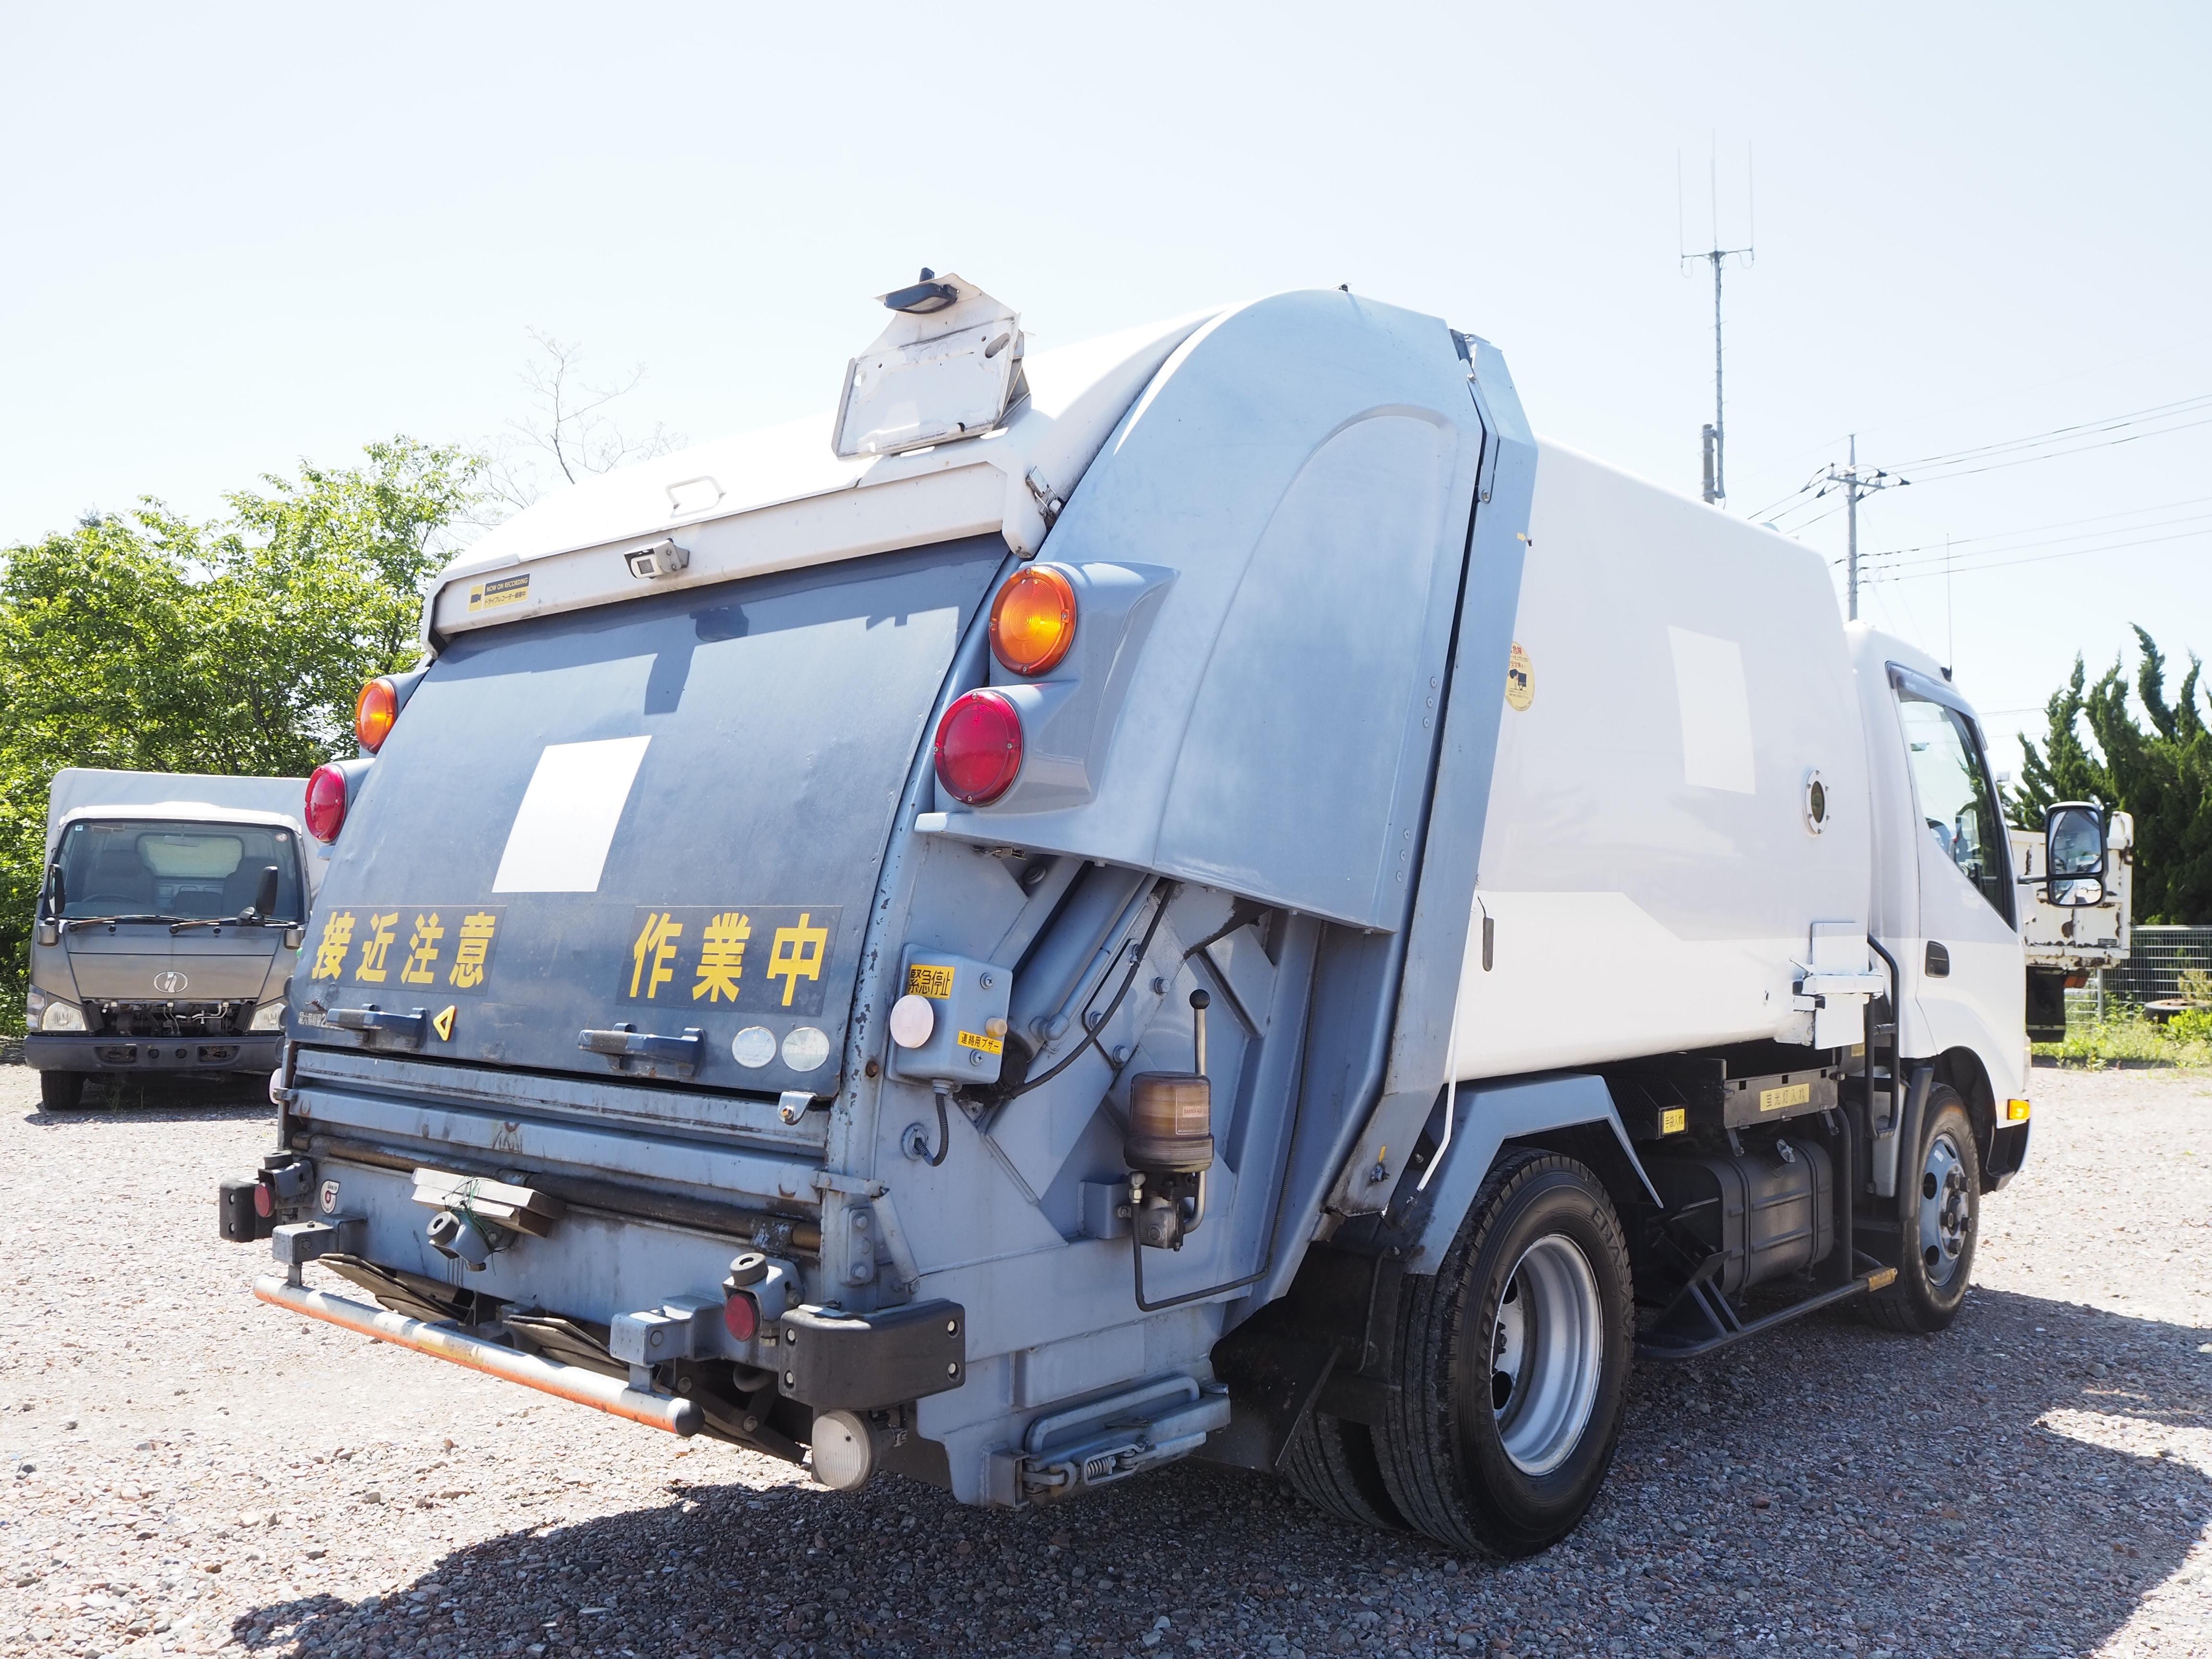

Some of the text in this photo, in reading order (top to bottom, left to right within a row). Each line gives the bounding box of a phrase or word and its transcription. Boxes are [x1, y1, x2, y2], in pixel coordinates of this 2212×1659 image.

[505, 577, 528, 588] RECORDING
[312, 912, 496, 988] 接近注意
[629, 913, 828, 1006] 作業中
[908, 969, 950, 996] 緊急停止
[961, 1032, 999, 1050] 連絡用ブザー
